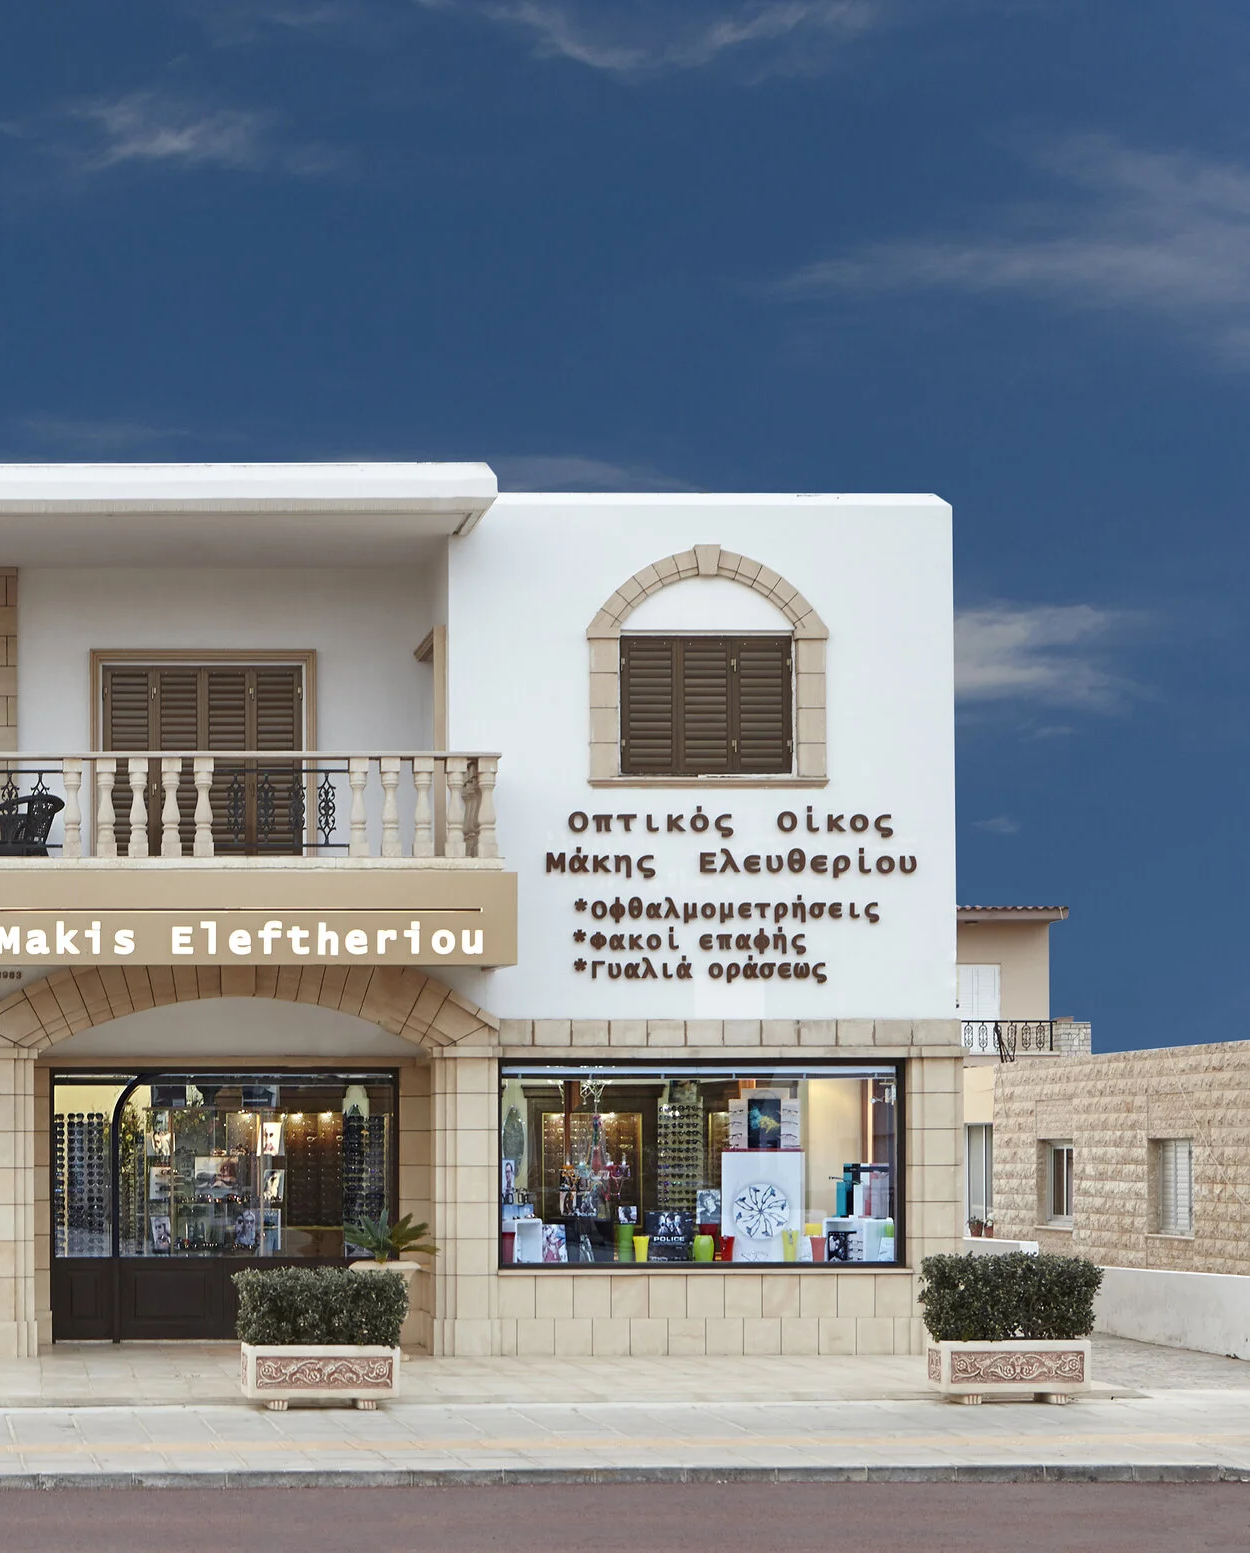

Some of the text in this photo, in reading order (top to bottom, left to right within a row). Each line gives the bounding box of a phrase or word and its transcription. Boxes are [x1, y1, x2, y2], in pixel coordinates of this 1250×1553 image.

[567, 805, 894, 838] Οπτικός Οίκος
[546, 846, 918, 879] Μάκης Ελευθερίου
[171, 920, 484, 956] Eleftheriou
[698, 926, 807, 955] επαφής
[707, 955, 828, 984] οράσεως
